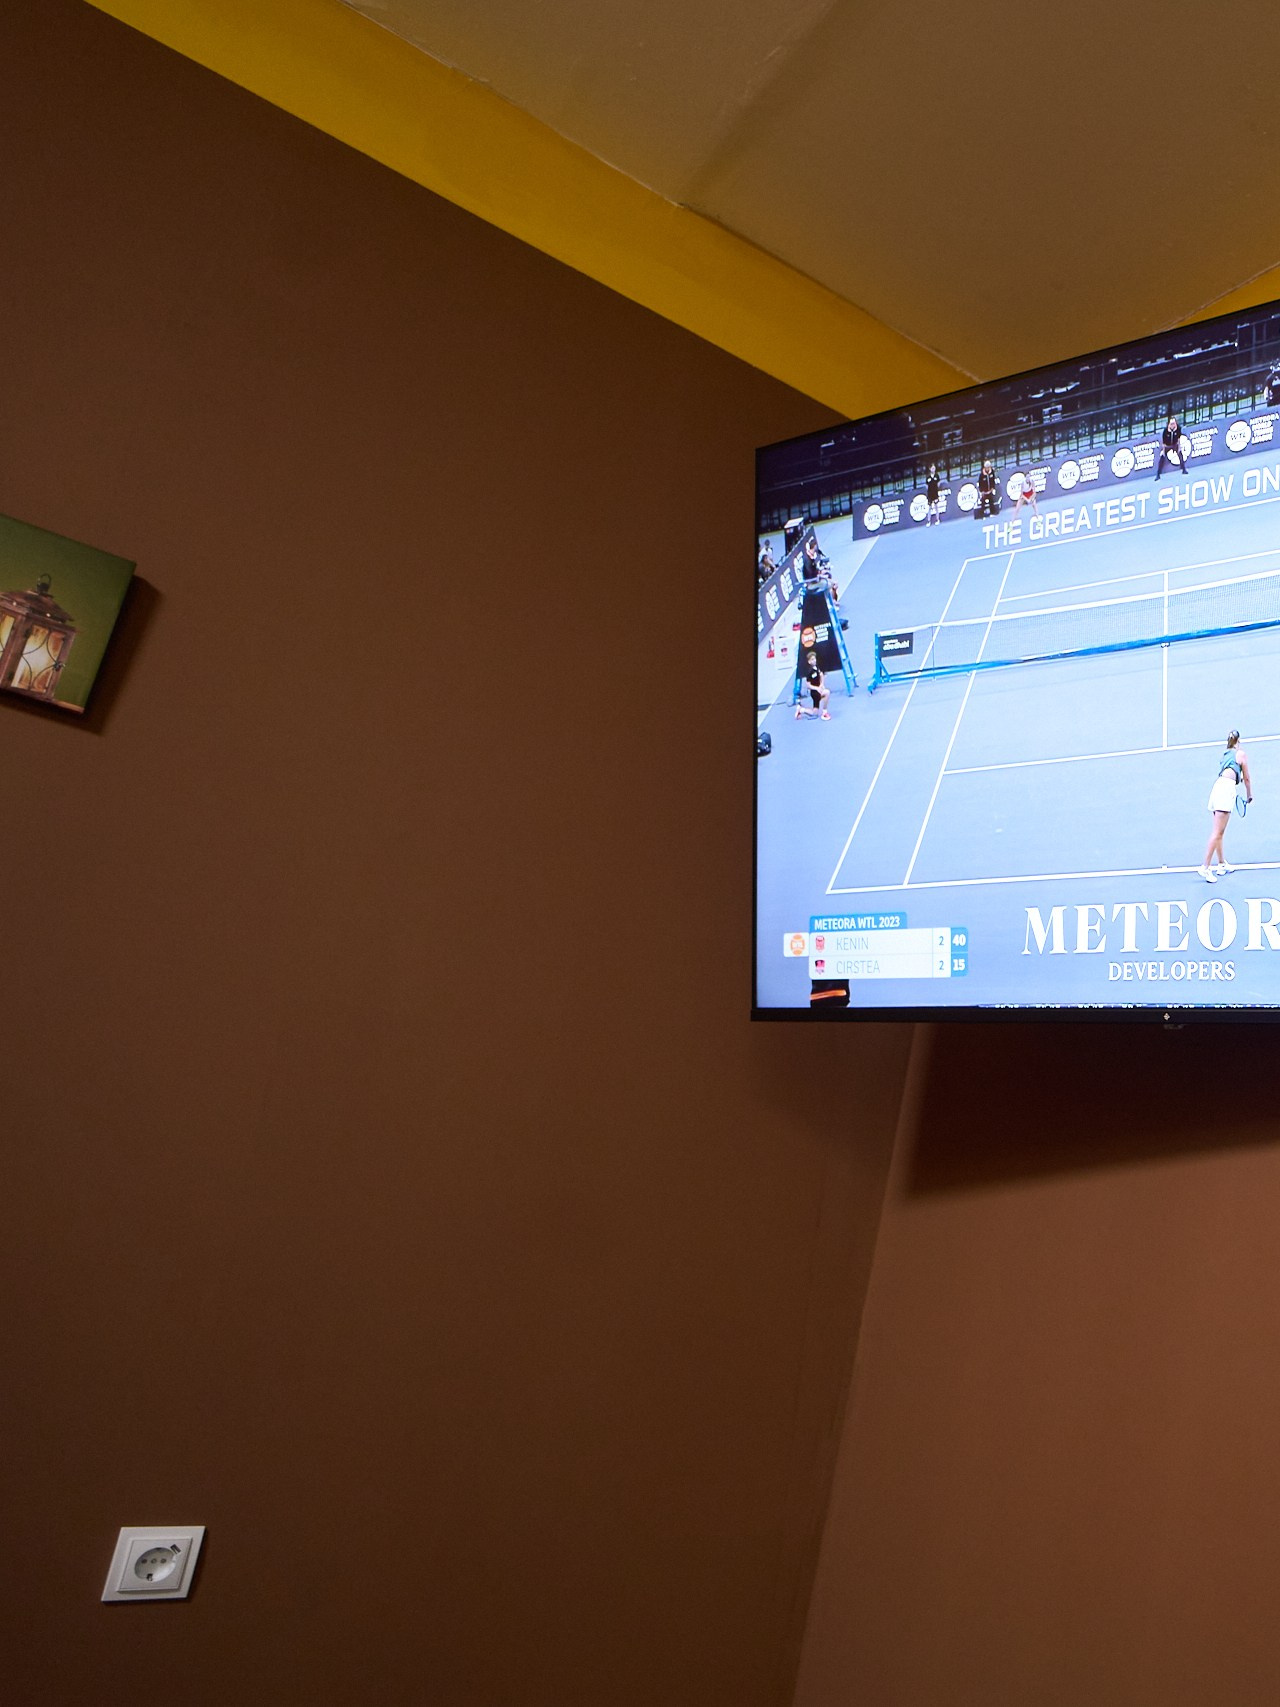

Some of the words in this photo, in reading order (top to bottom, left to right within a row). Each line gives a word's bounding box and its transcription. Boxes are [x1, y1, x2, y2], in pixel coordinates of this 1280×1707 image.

[982, 519, 1022, 550] THE
[1029, 491, 1152, 540] GREATEST
[1158, 474, 1235, 516] SHOW
[814, 917, 856, 931] METEORA
[857, 916, 877, 930] WTL
[879, 915, 900, 929] 2023
[836, 937, 869, 951] KENIN
[938, 935, 945, 946] 2
[952, 934, 967, 947] 40
[836, 960, 881, 974] CIRSTEA
[938, 960, 945, 971] 2
[952, 958, 966, 971] 15
[1108, 960, 1236, 982] DEVELOPERS
